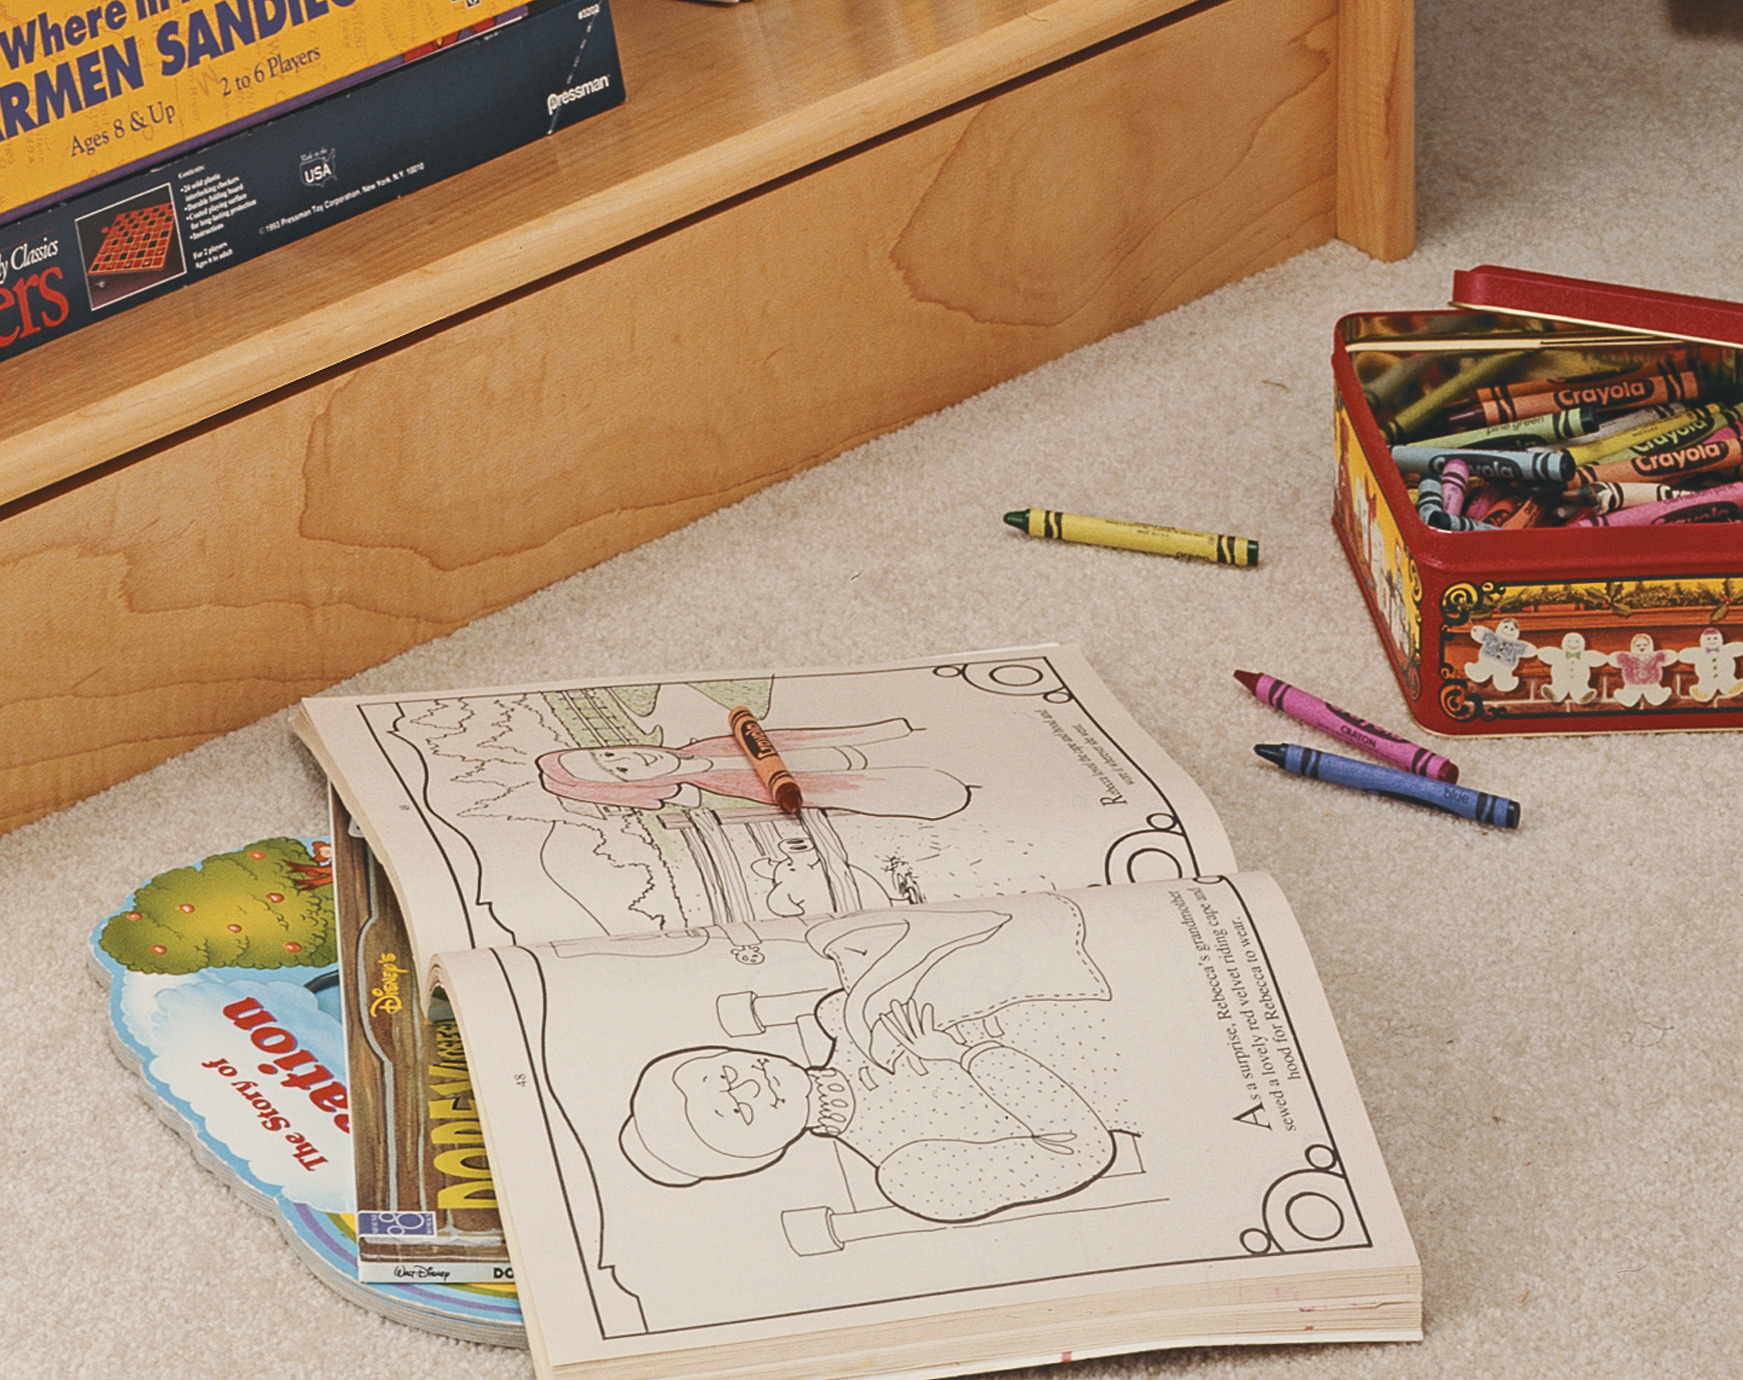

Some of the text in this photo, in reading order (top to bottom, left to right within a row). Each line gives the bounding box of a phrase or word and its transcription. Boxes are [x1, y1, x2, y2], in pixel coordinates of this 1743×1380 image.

[220, 44, 322, 98] 2 to 6 Players
[69, 98, 176, 158] Ages 8 & Up
[304, 162, 332, 184] USA
[10, 237, 60, 273] Classics
[1557, 380, 1647, 407] Crayola
[1634, 442, 1722, 471] Crayola
[1340, 724, 1377, 749] CRAYON
[1442, 787, 1469, 805] blue
[1168, 890, 1211, 954] grandmother
[1201, 902, 1221, 928] cape
[1231, 916, 1252, 949] wear.
[1213, 927, 1236, 967] riding
[1198, 954, 1232, 1022] Rebecca's
[1225, 968, 1251, 1008] velvet
[1254, 963, 1280, 1022] Rebecca
[1240, 1008, 1261, 1032] red
[1271, 1021, 1289, 1045] for
[1225, 1022, 1254, 1082] surprise,
[1250, 1032, 1274, 1077] lovely
[1277, 1046, 1302, 1082] hood
[201, 1057, 329, 1172] The Story of
[1268, 1089, 1297, 1132] sewed
